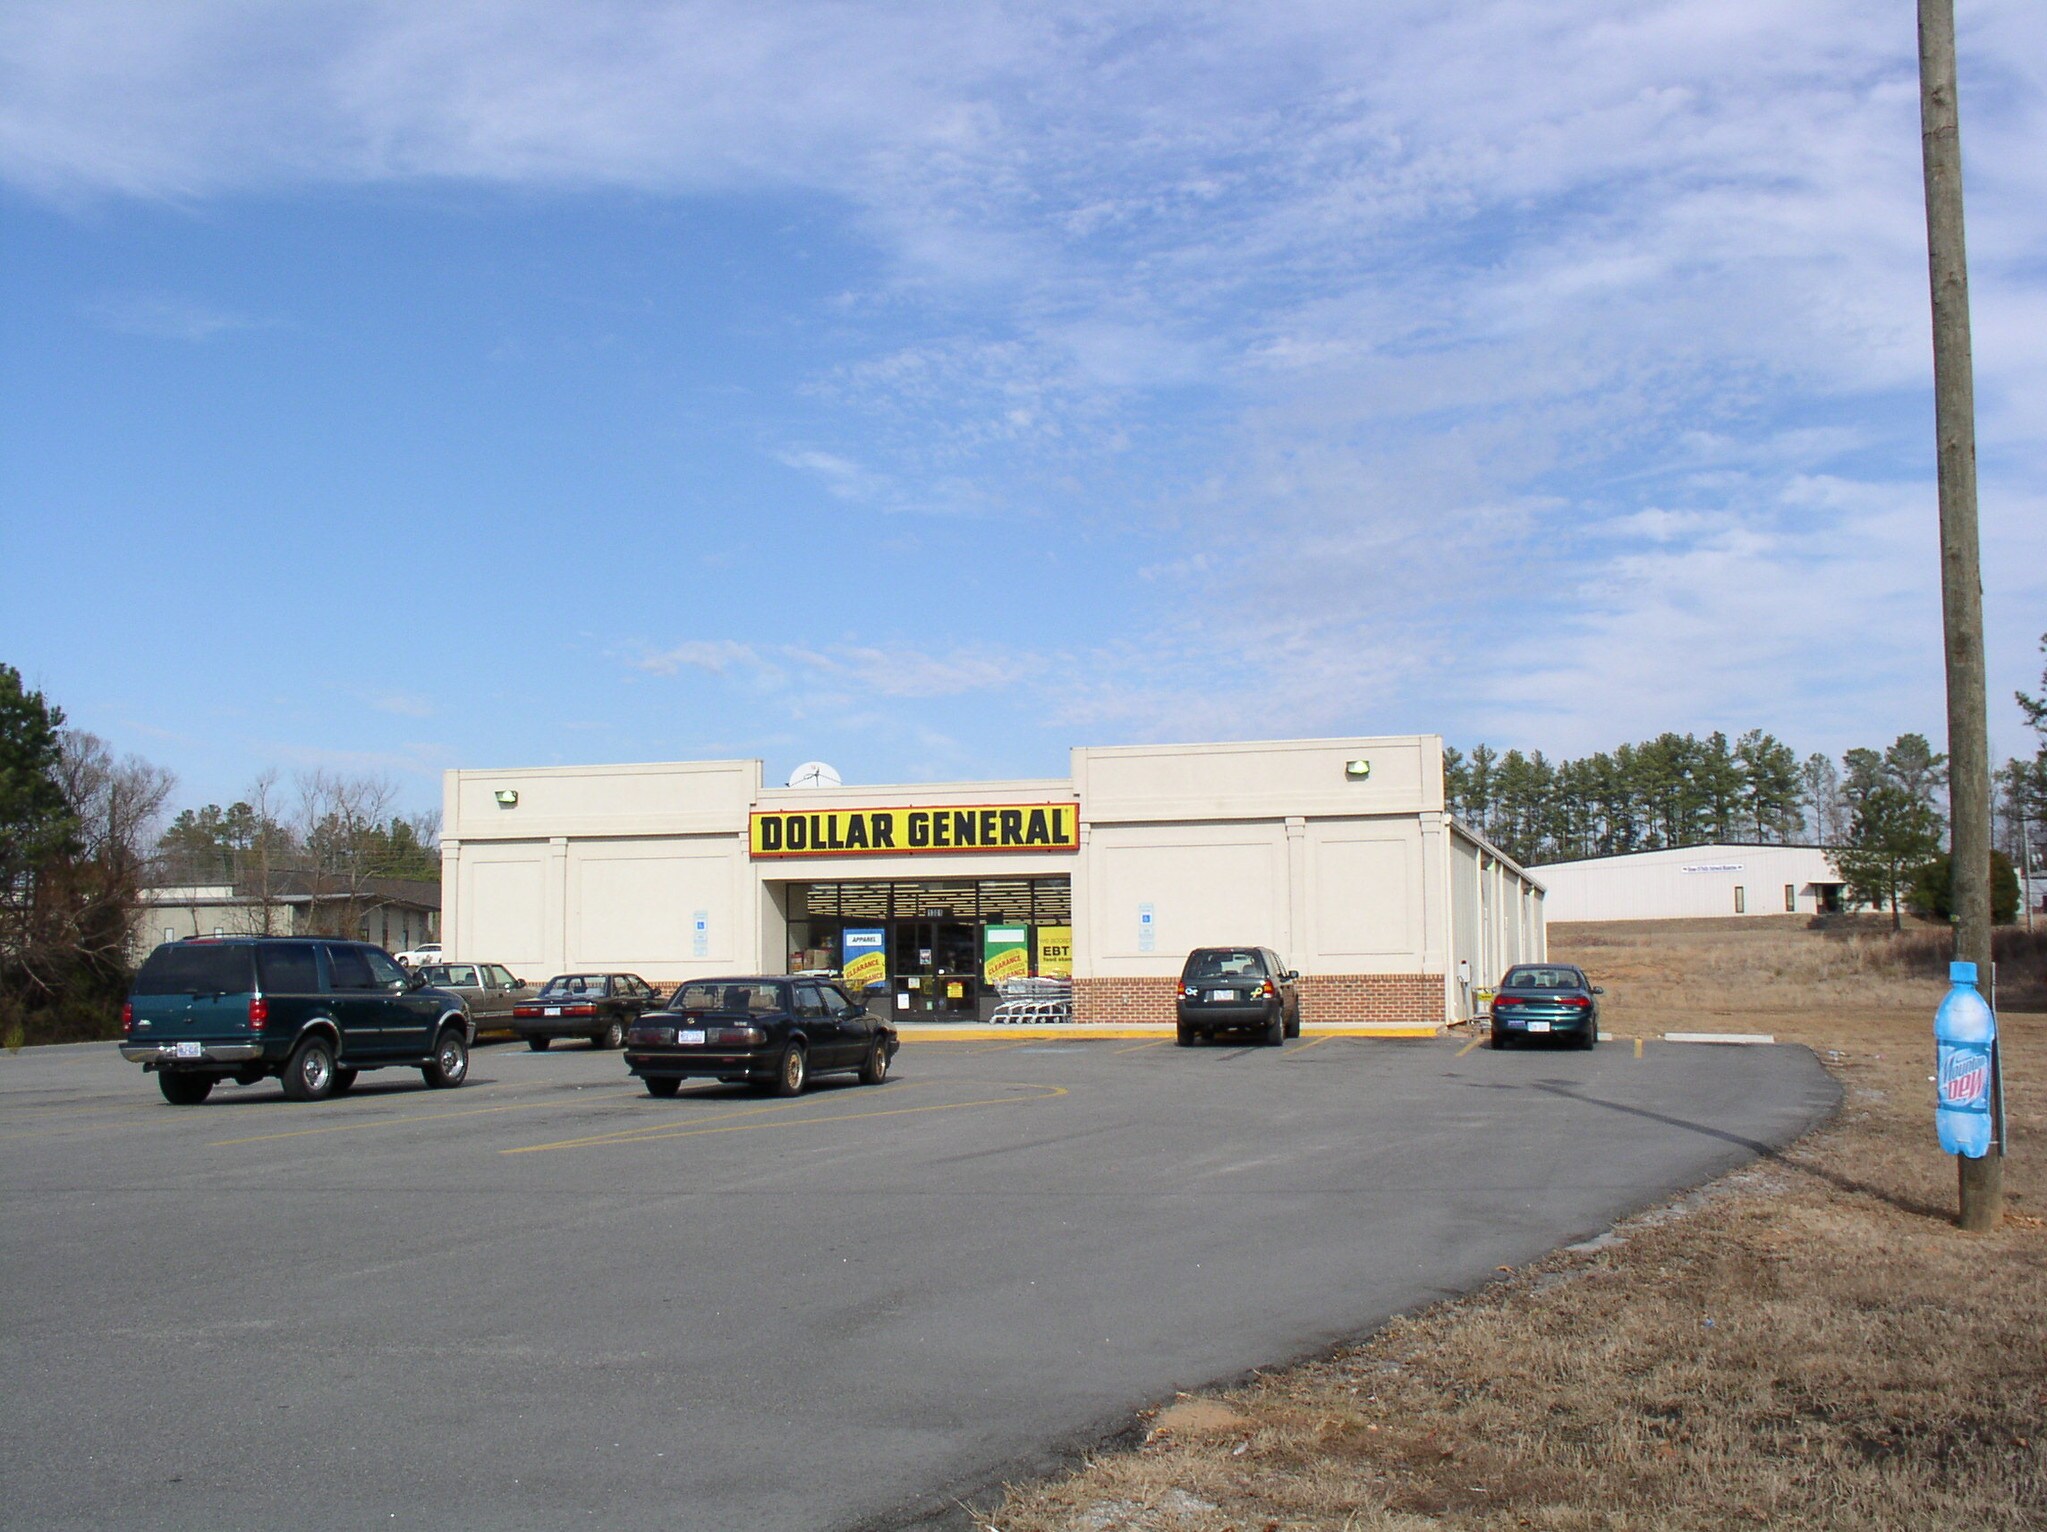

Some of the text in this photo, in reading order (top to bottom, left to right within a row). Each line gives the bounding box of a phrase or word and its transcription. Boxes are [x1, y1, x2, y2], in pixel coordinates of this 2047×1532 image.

[761, 808, 1069, 850] DOLLAR GENERAL
[1043, 945, 1070, 956] EBT
[846, 958, 879, 978] CLEARANCE
[988, 954, 1022, 975] CLEARANCE
